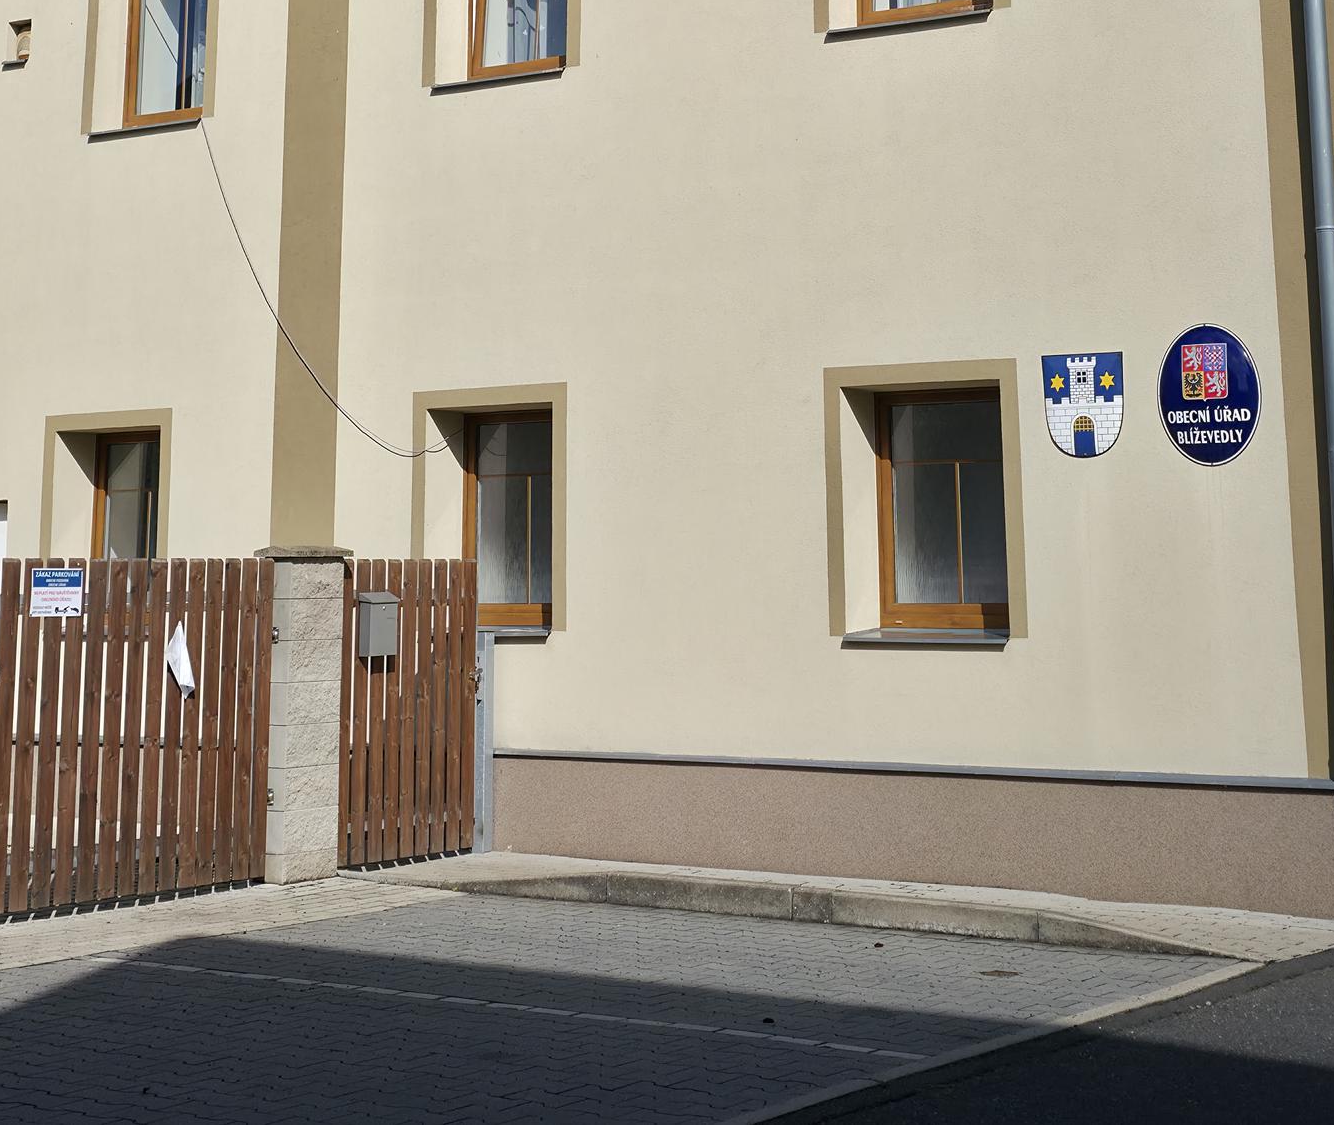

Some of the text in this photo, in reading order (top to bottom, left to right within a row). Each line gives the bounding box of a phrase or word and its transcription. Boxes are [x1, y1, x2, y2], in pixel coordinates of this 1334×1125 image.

[1167, 405, 1251, 424] OBECNÍ ÚŘAD
[1177, 427, 1243, 444] BLÍŽEVEDLY
